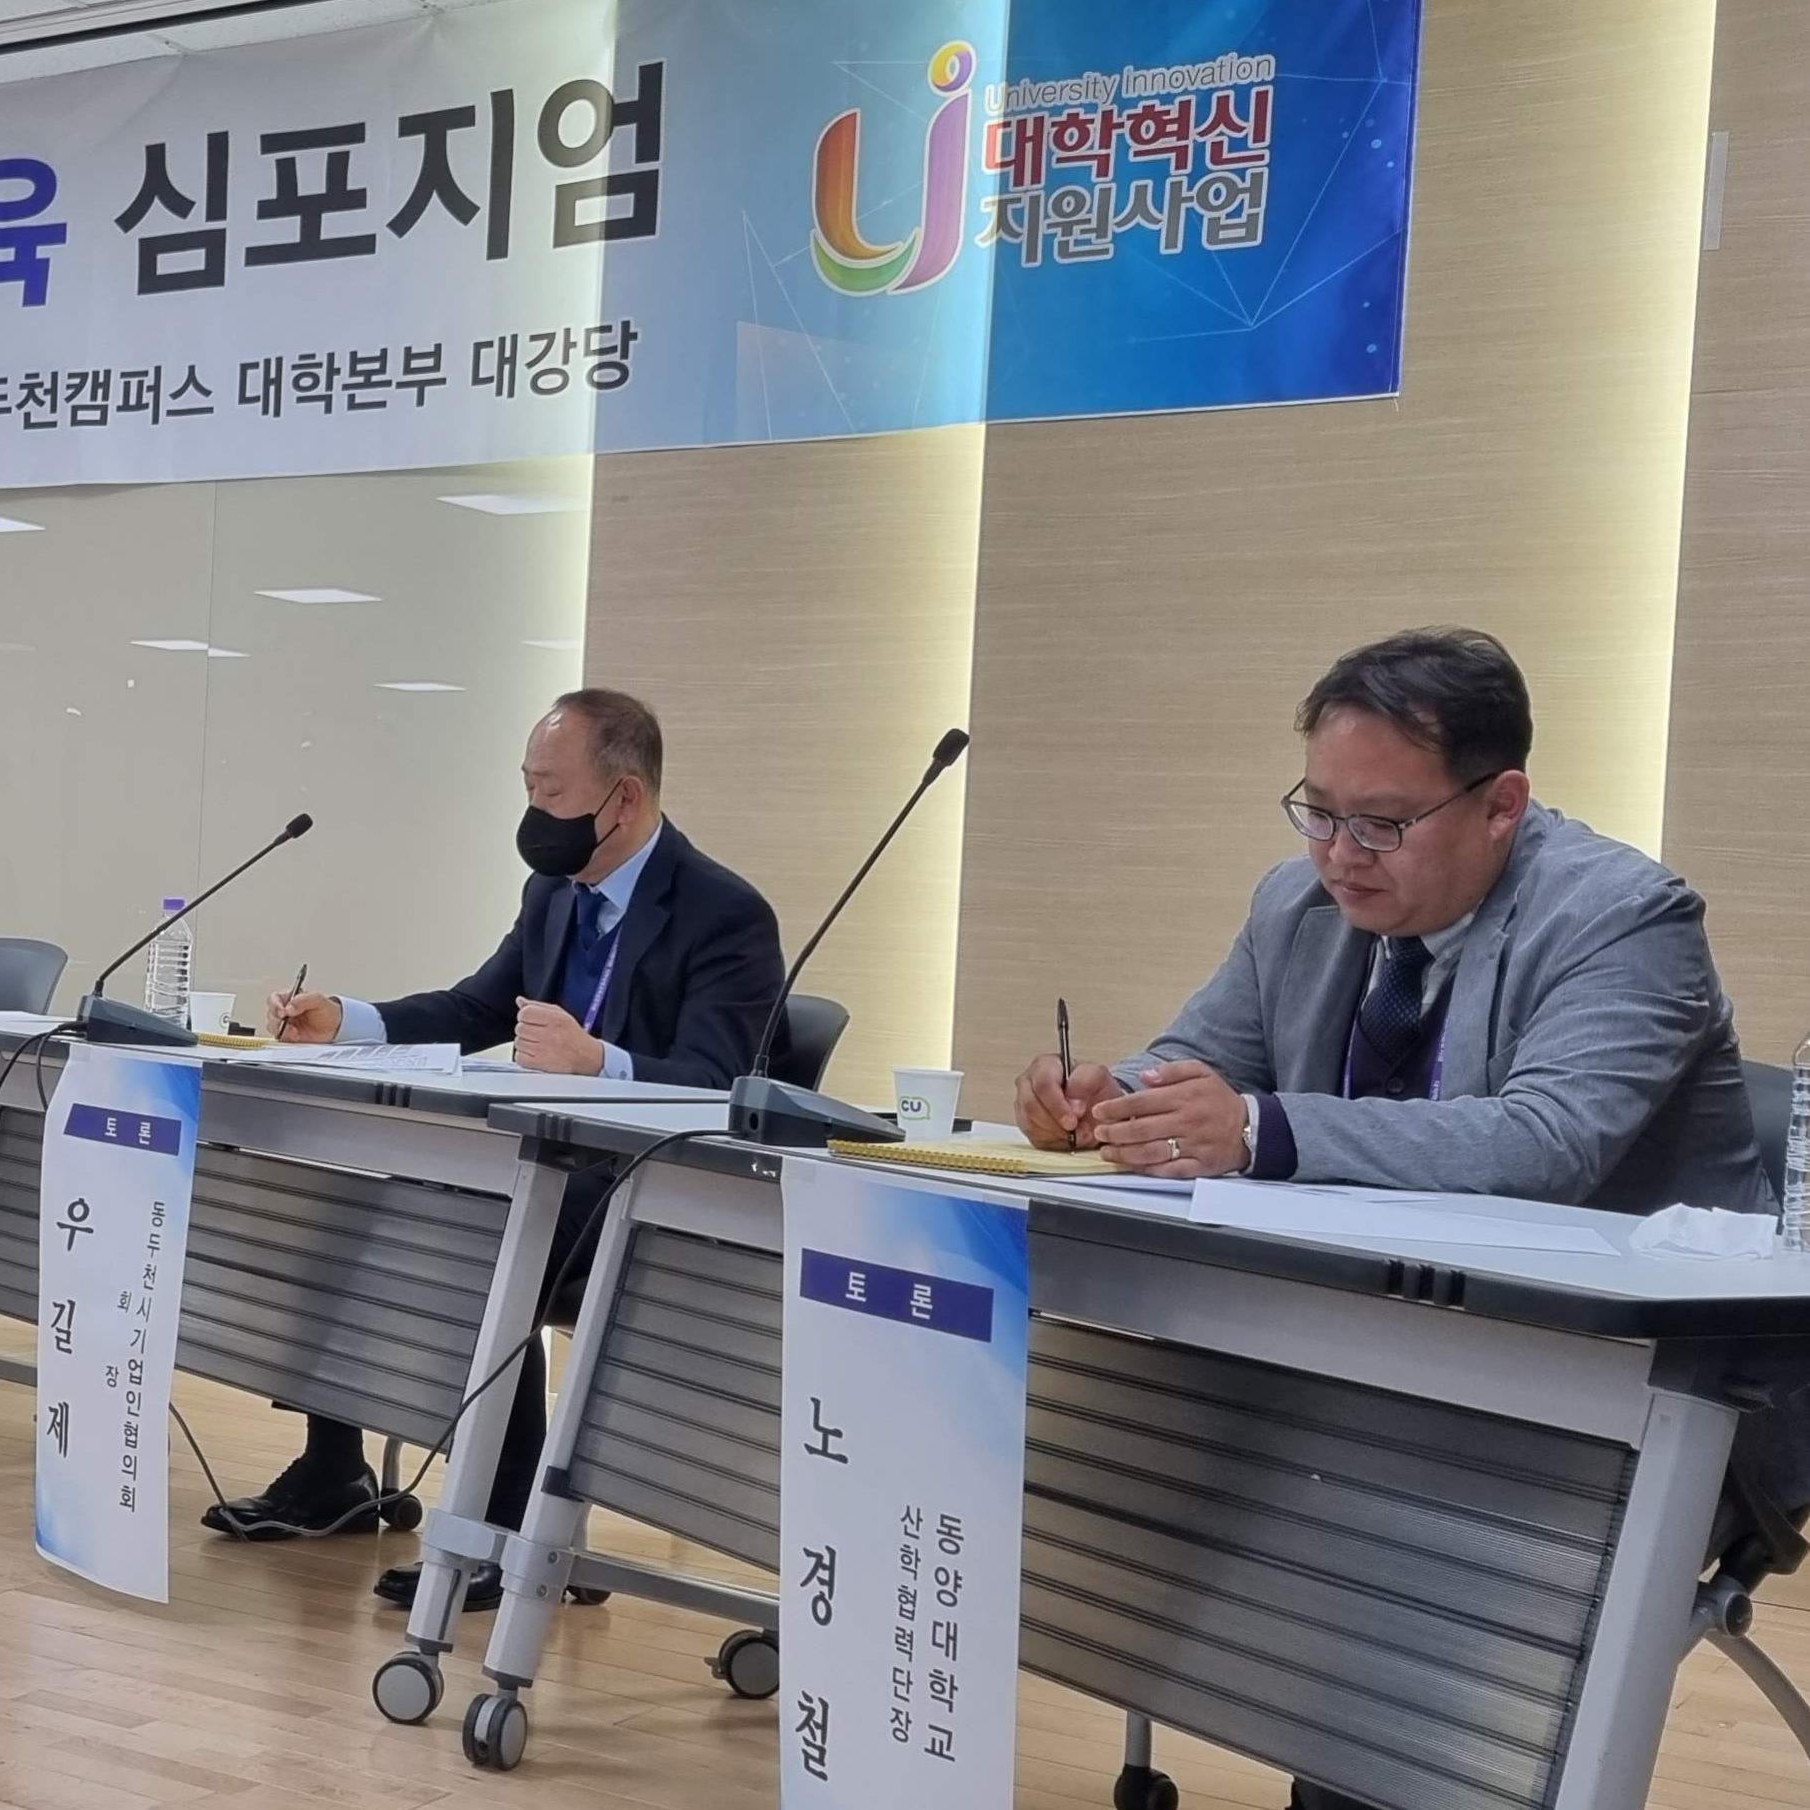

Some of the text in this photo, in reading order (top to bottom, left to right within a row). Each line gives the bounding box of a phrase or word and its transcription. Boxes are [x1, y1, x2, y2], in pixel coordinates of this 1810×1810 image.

[114, 60, 665, 296] 심포지엄
[984, 89, 1271, 188] 대학혁신
[987, 54, 1274, 111] University Innovation
[977, 171, 1267, 267] 지원사업
[238, 343, 447, 419] 대학본부
[472, 320, 639, 399] 대강당
[901, 1100, 921, 1112] CU
[46, 1197, 93, 1459] 우길제
[119, 1200, 166, 1513] 동두천시기업인협의회
[794, 1396, 849, 1782] 노경철
[889, 1504, 924, 1744] 산학협력단장
[925, 1514, 965, 1764] 동양대학교
